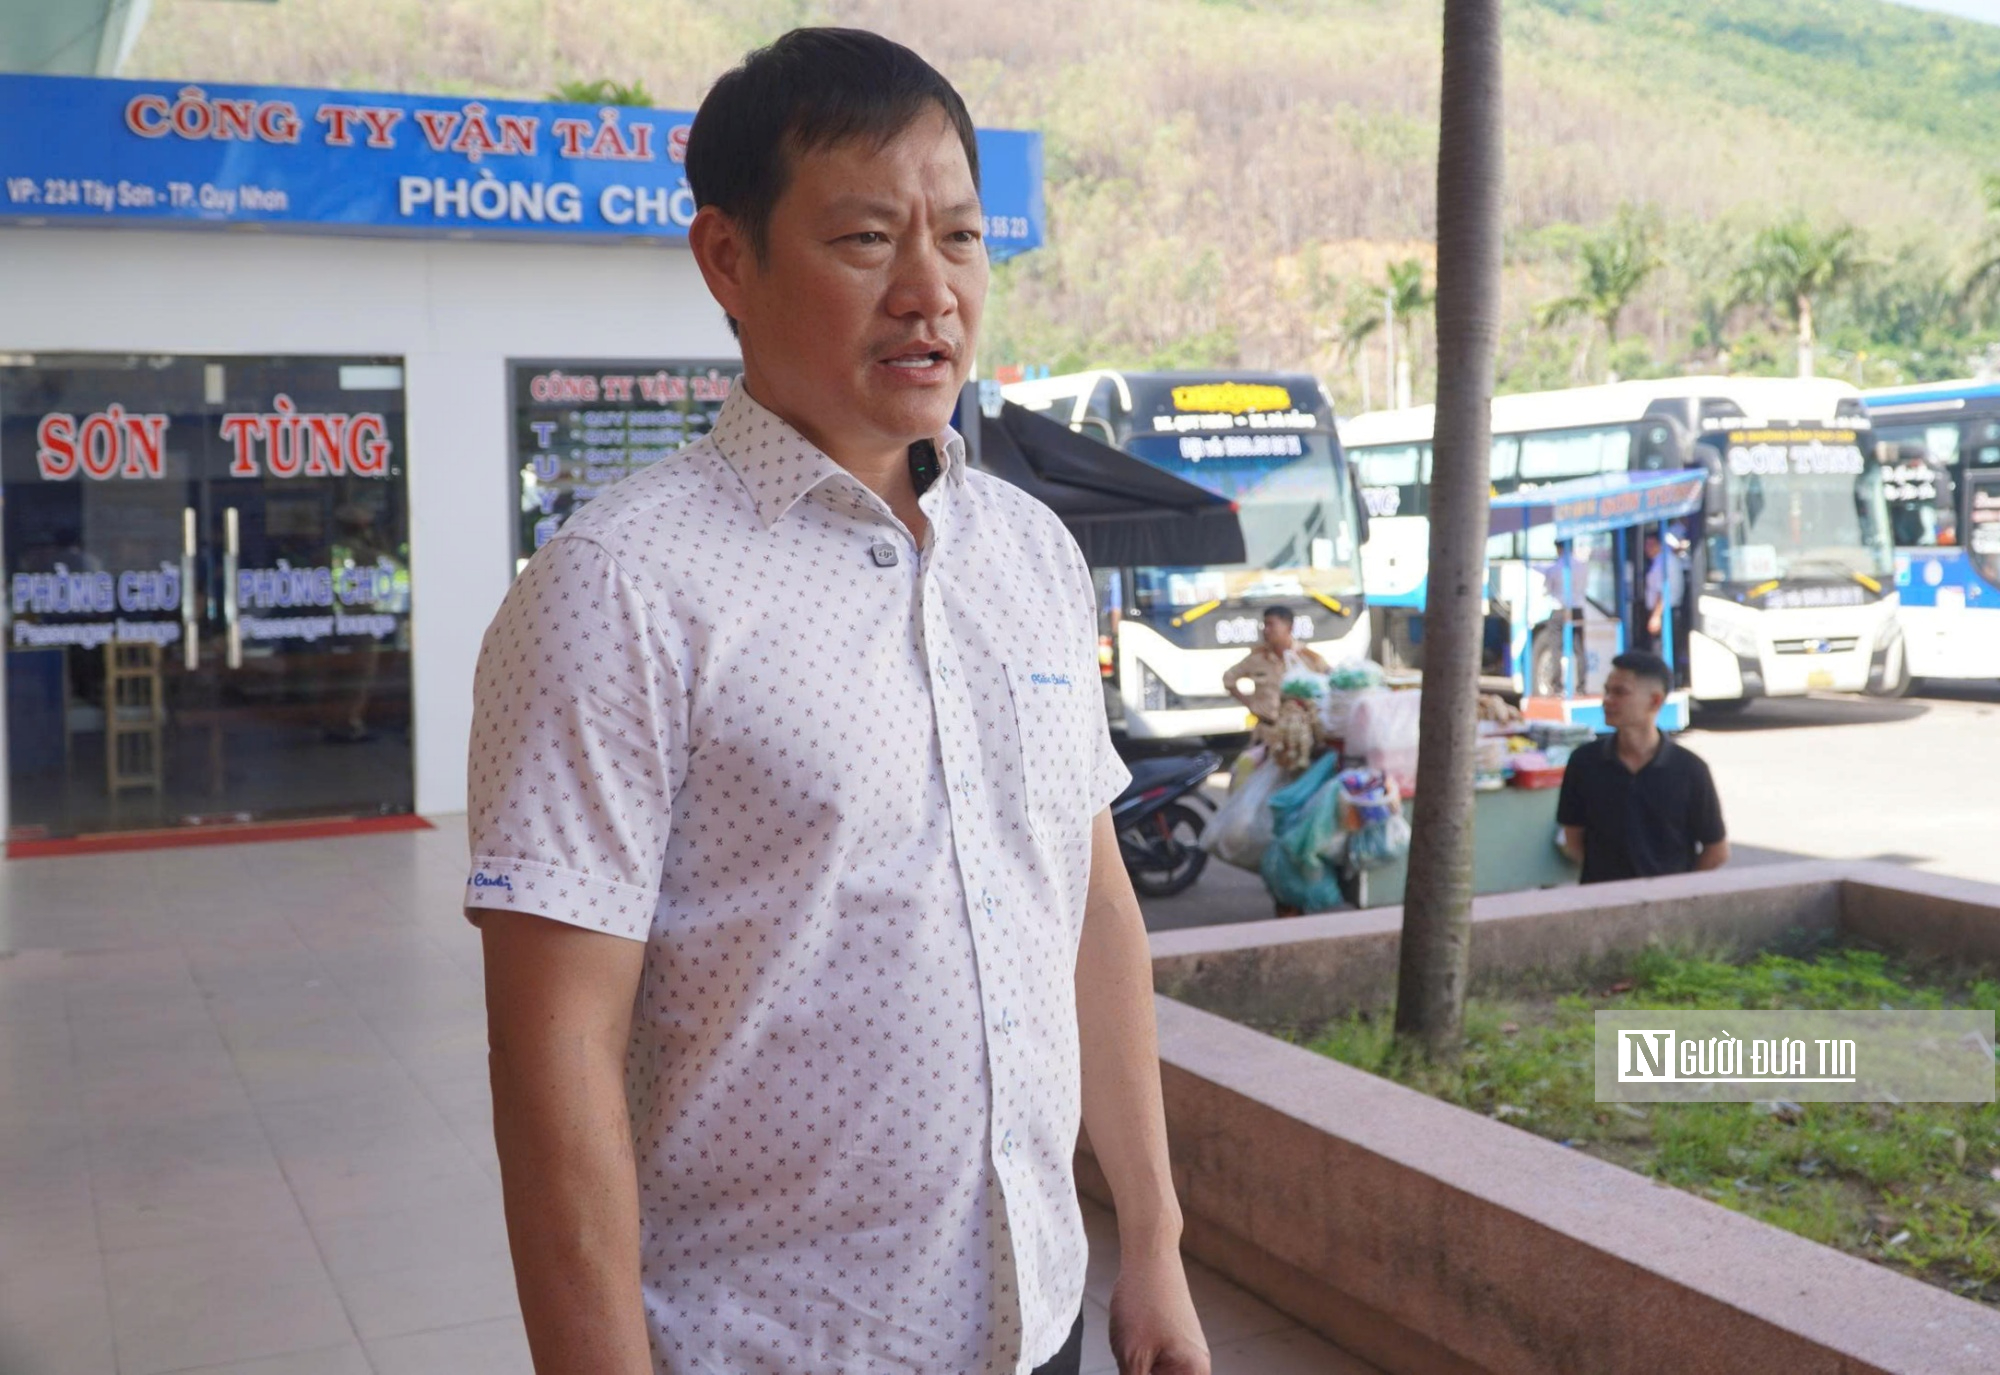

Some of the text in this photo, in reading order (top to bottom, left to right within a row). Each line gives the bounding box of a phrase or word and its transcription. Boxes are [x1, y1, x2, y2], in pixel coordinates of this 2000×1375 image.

[126, 86, 300, 144] CÔNG
[317, 104, 402, 149] TY
[414, 101, 539, 163] VẬN
[552, 106, 655, 161] TẢI
[199, 183, 236, 214] Quy
[400, 167, 582, 223] PHÒNG
[530, 369, 599, 401] CÔNG
[602, 374, 634, 401] TY
[637, 369, 688, 406] VẬN
[37, 393, 391, 480] SƠN TÙNG
[12, 560, 181, 614] PHÒNG CHỜ
[237, 558, 333, 608] PHÒNG
[14, 619, 114, 649] Passenger
